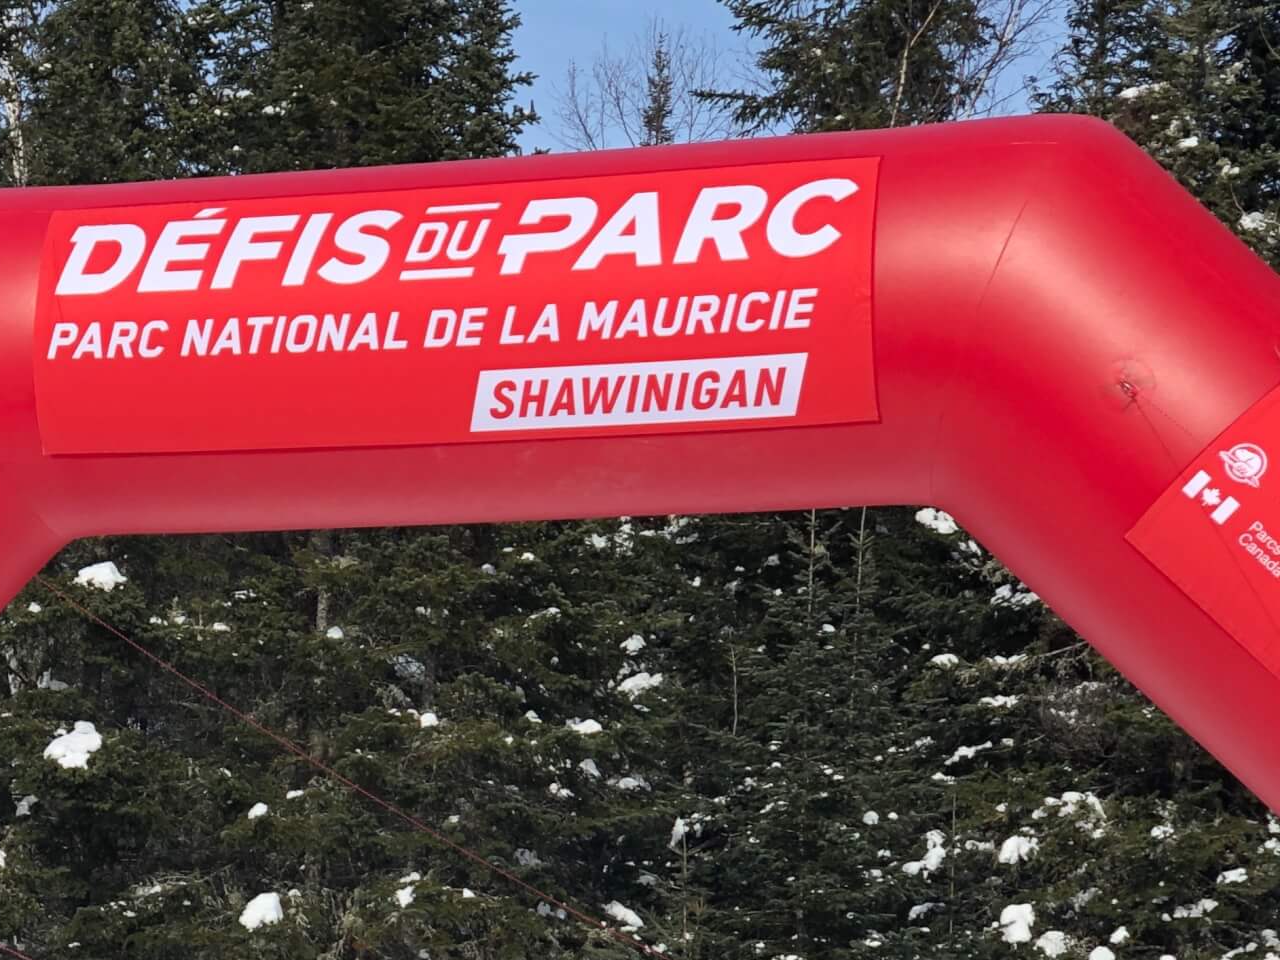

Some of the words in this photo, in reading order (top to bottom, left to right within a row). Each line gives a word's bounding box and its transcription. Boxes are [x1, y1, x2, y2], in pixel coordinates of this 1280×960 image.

[54, 207, 404, 296] DÉFIS
[404, 218, 491, 263] DU
[497, 178, 861, 277] PARC
[47, 320, 170, 361] PARC
[179, 312, 410, 358] NATIONAL
[423, 307, 489, 348] DE
[499, 303, 561, 346] LA
[577, 287, 819, 342] MAURICIE
[489, 366, 788, 421] SHAWINIGAN
